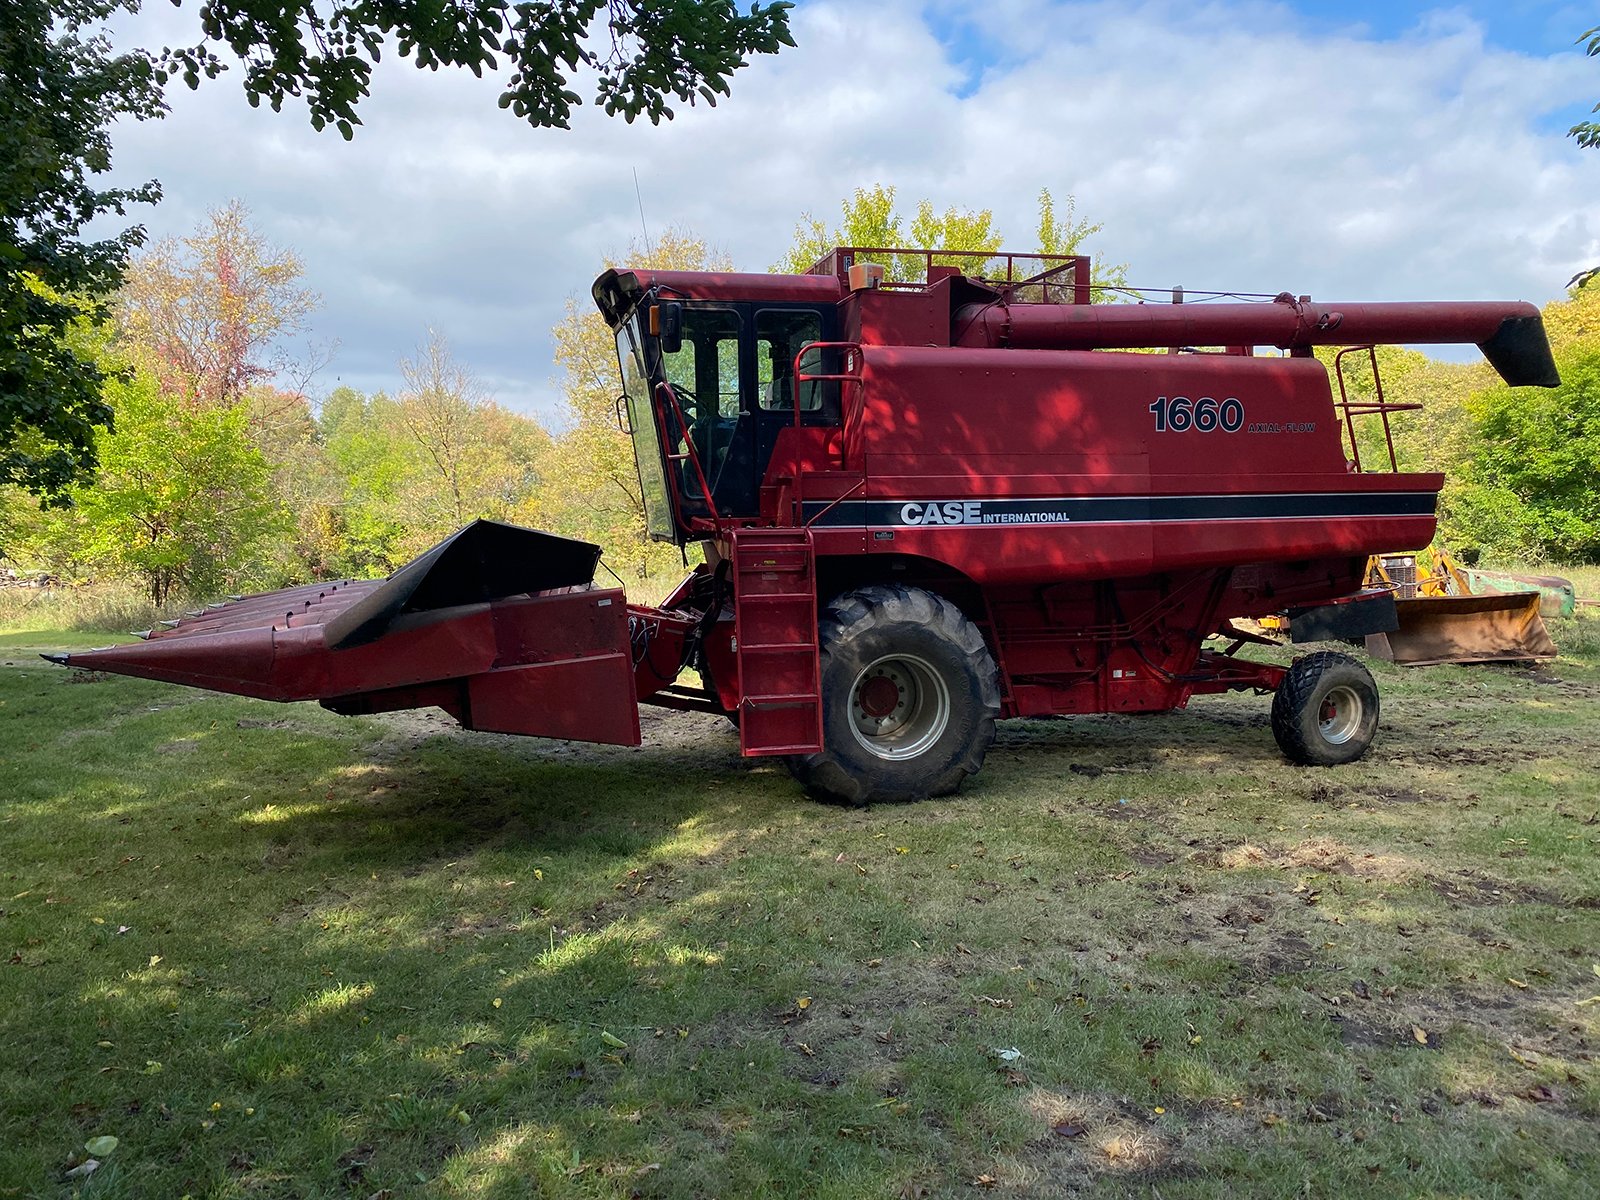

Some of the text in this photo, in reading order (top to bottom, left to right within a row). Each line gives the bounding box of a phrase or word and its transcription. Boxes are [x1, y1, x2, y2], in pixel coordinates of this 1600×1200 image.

[1149, 396, 1317, 434] 1660 AXIAL-FLOW
[900, 502, 1070, 525] CASE INTERNATIONAL
